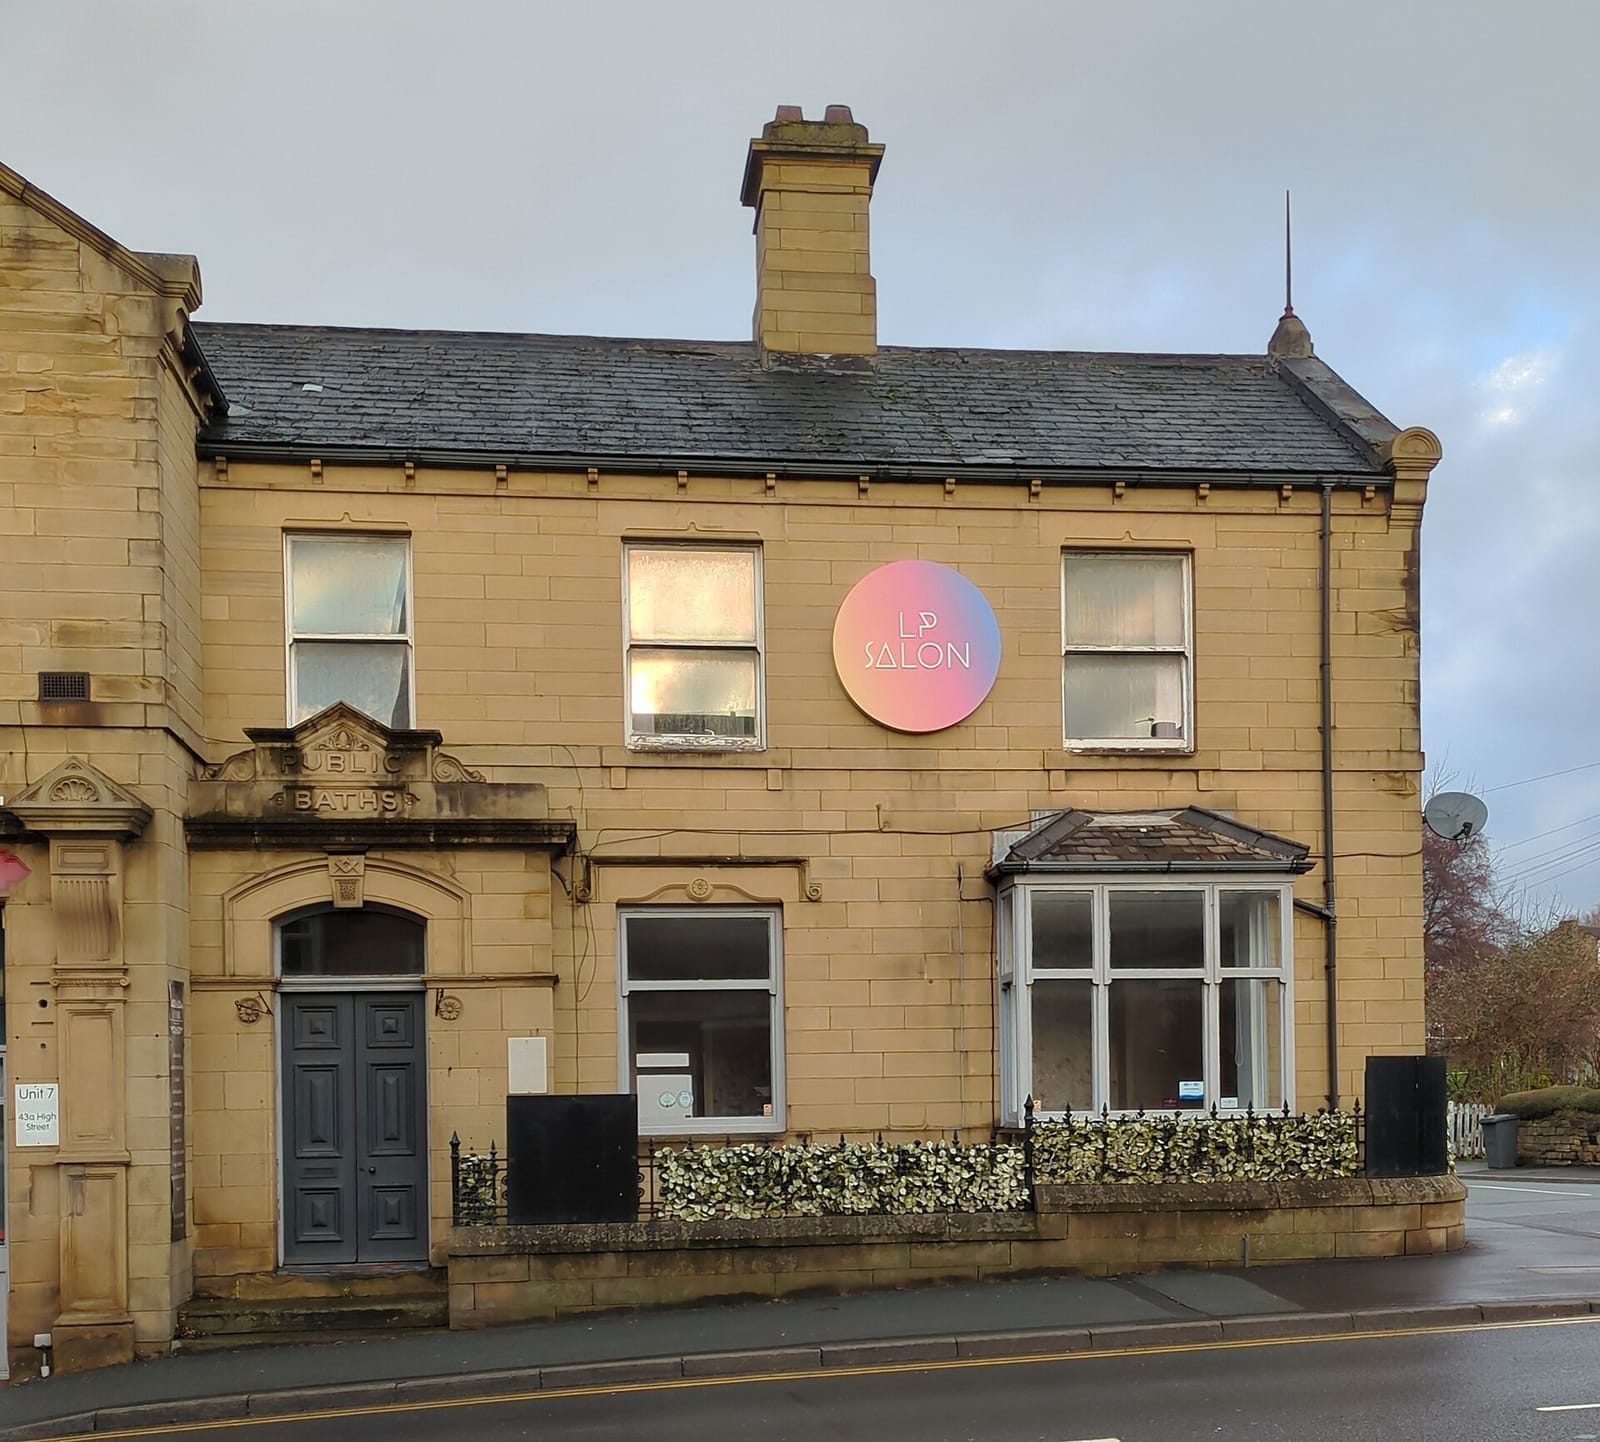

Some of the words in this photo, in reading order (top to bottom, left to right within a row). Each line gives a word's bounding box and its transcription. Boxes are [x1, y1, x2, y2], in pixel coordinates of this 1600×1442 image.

[899, 611, 937, 638] LP
[865, 641, 970, 669] SALON
[280, 752, 401, 774] PUBLIC
[295, 790, 399, 811] BATHS
[19, 1088, 43, 1099] Unit
[47, 1088, 54, 1099] 7
[18, 1113, 35, 1121] 43a
[37, 1112, 56, 1122] High
[26, 1123, 49, 1131] Street
